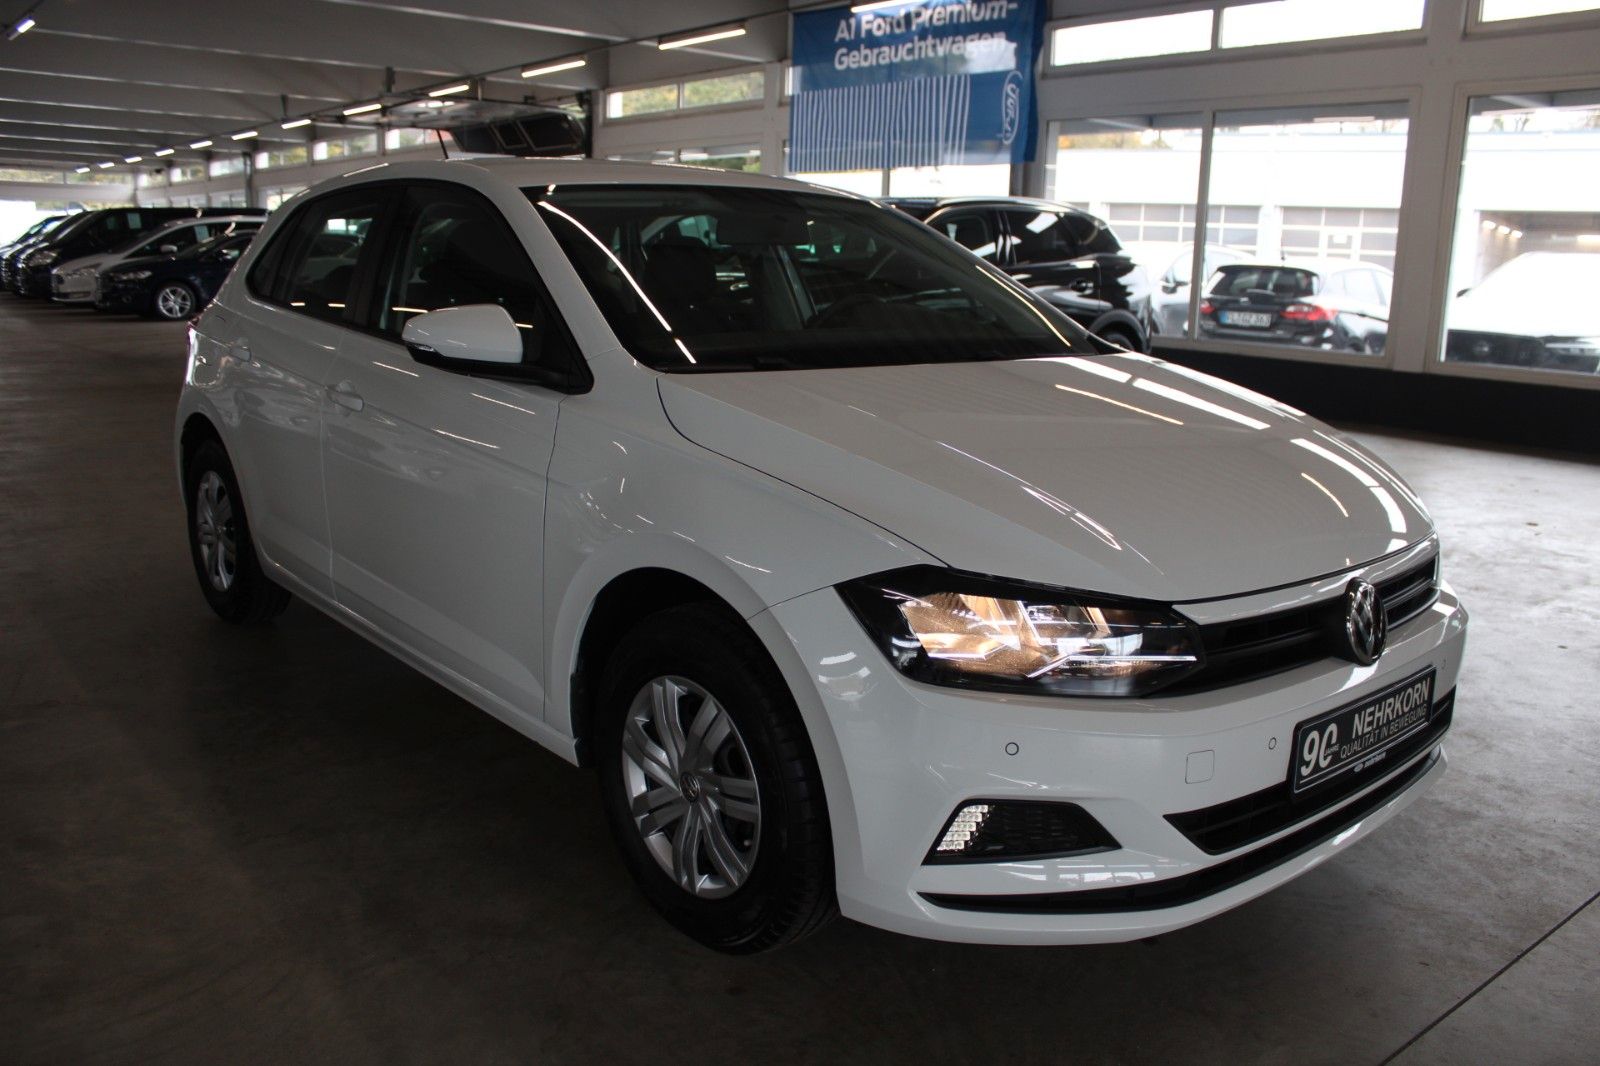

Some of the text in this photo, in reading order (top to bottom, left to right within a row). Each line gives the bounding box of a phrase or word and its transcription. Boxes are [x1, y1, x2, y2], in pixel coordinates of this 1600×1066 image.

[861, 8, 906, 39] Ford
[911, 0, 1018, 31] Premium-
[834, 31, 1007, 70] Gebrauchtwagen
[1340, 704, 1427, 759] QUALITÄT IN BEWEGUNG
[1352, 678, 1430, 739] NEHRKORN
